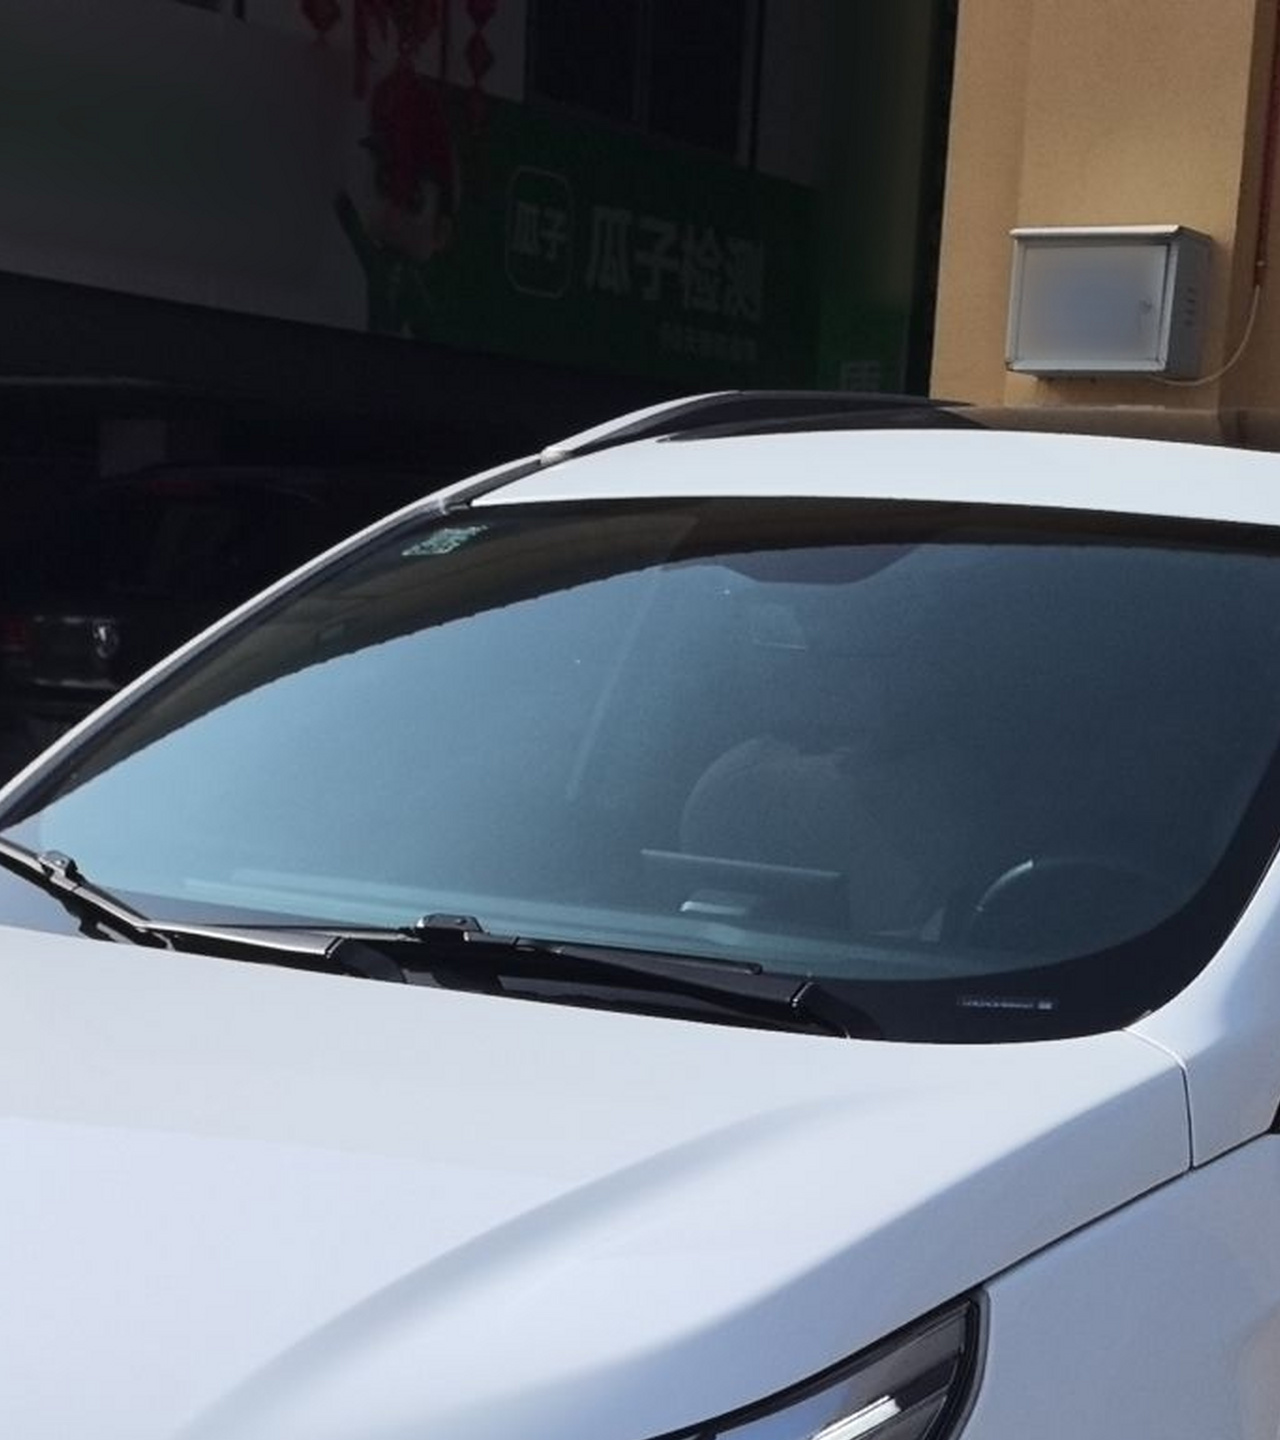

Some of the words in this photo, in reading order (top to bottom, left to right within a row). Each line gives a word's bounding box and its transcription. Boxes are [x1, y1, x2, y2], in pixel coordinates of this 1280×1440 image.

[511, 200, 568, 262] 瓜子
[584, 204, 765, 323] 瓜子检测
